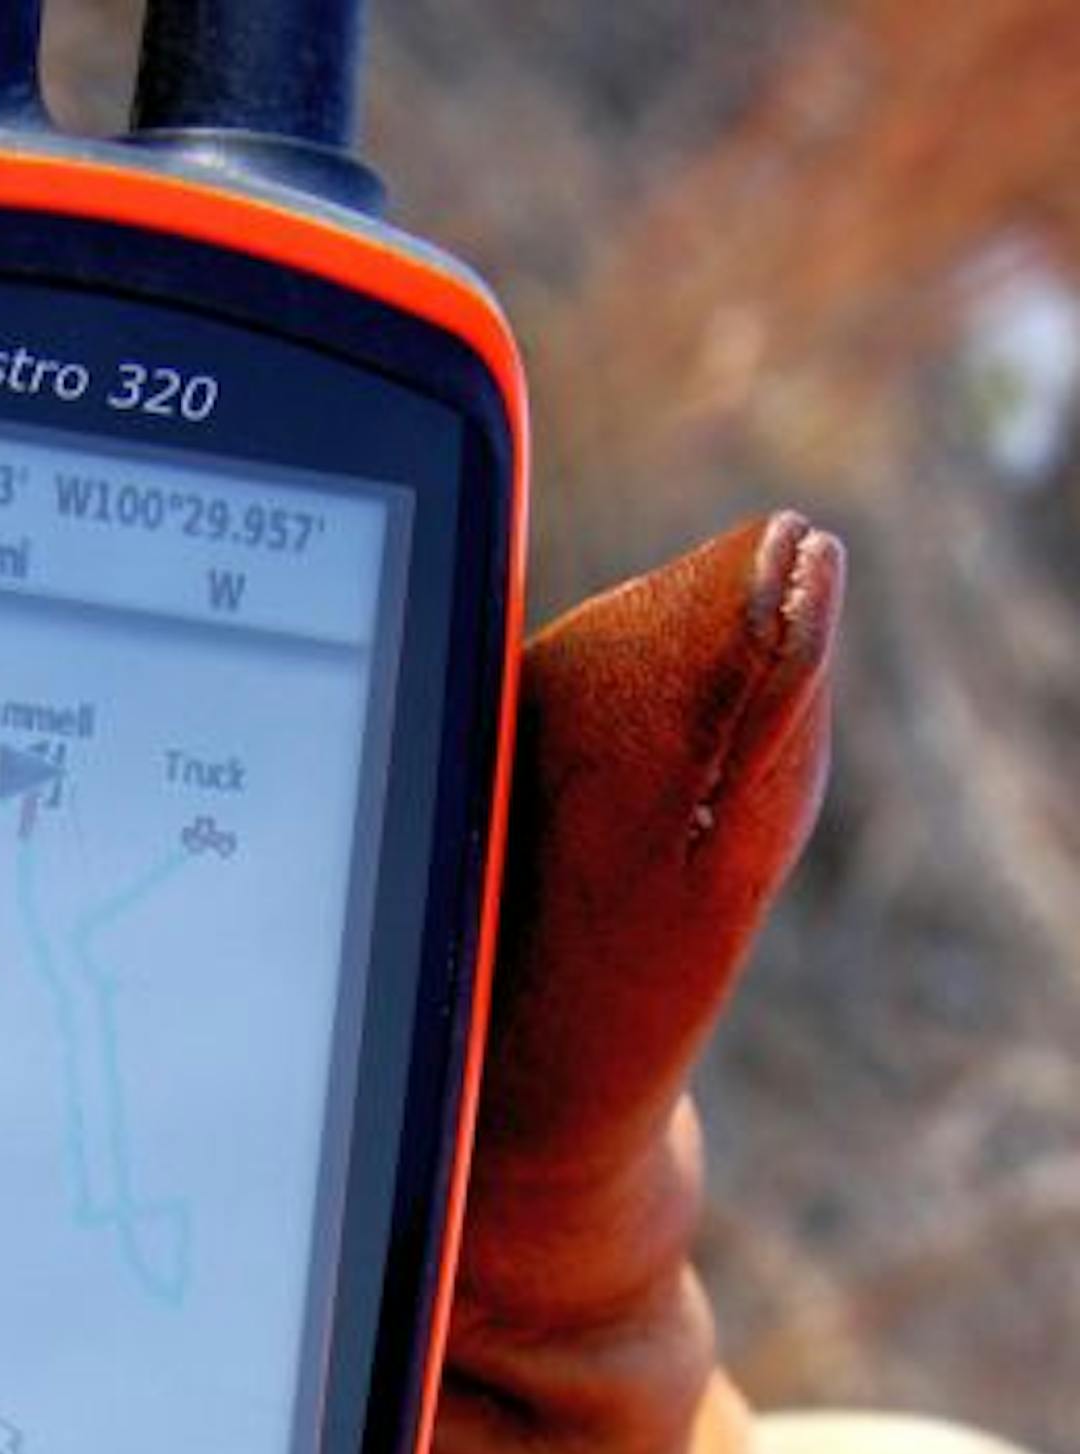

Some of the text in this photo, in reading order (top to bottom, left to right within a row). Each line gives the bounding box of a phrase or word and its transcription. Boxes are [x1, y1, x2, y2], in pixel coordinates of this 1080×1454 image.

[107, 362, 219, 422] 320
[207, 570, 246, 612] W
[165, 750, 246, 790] Truck
